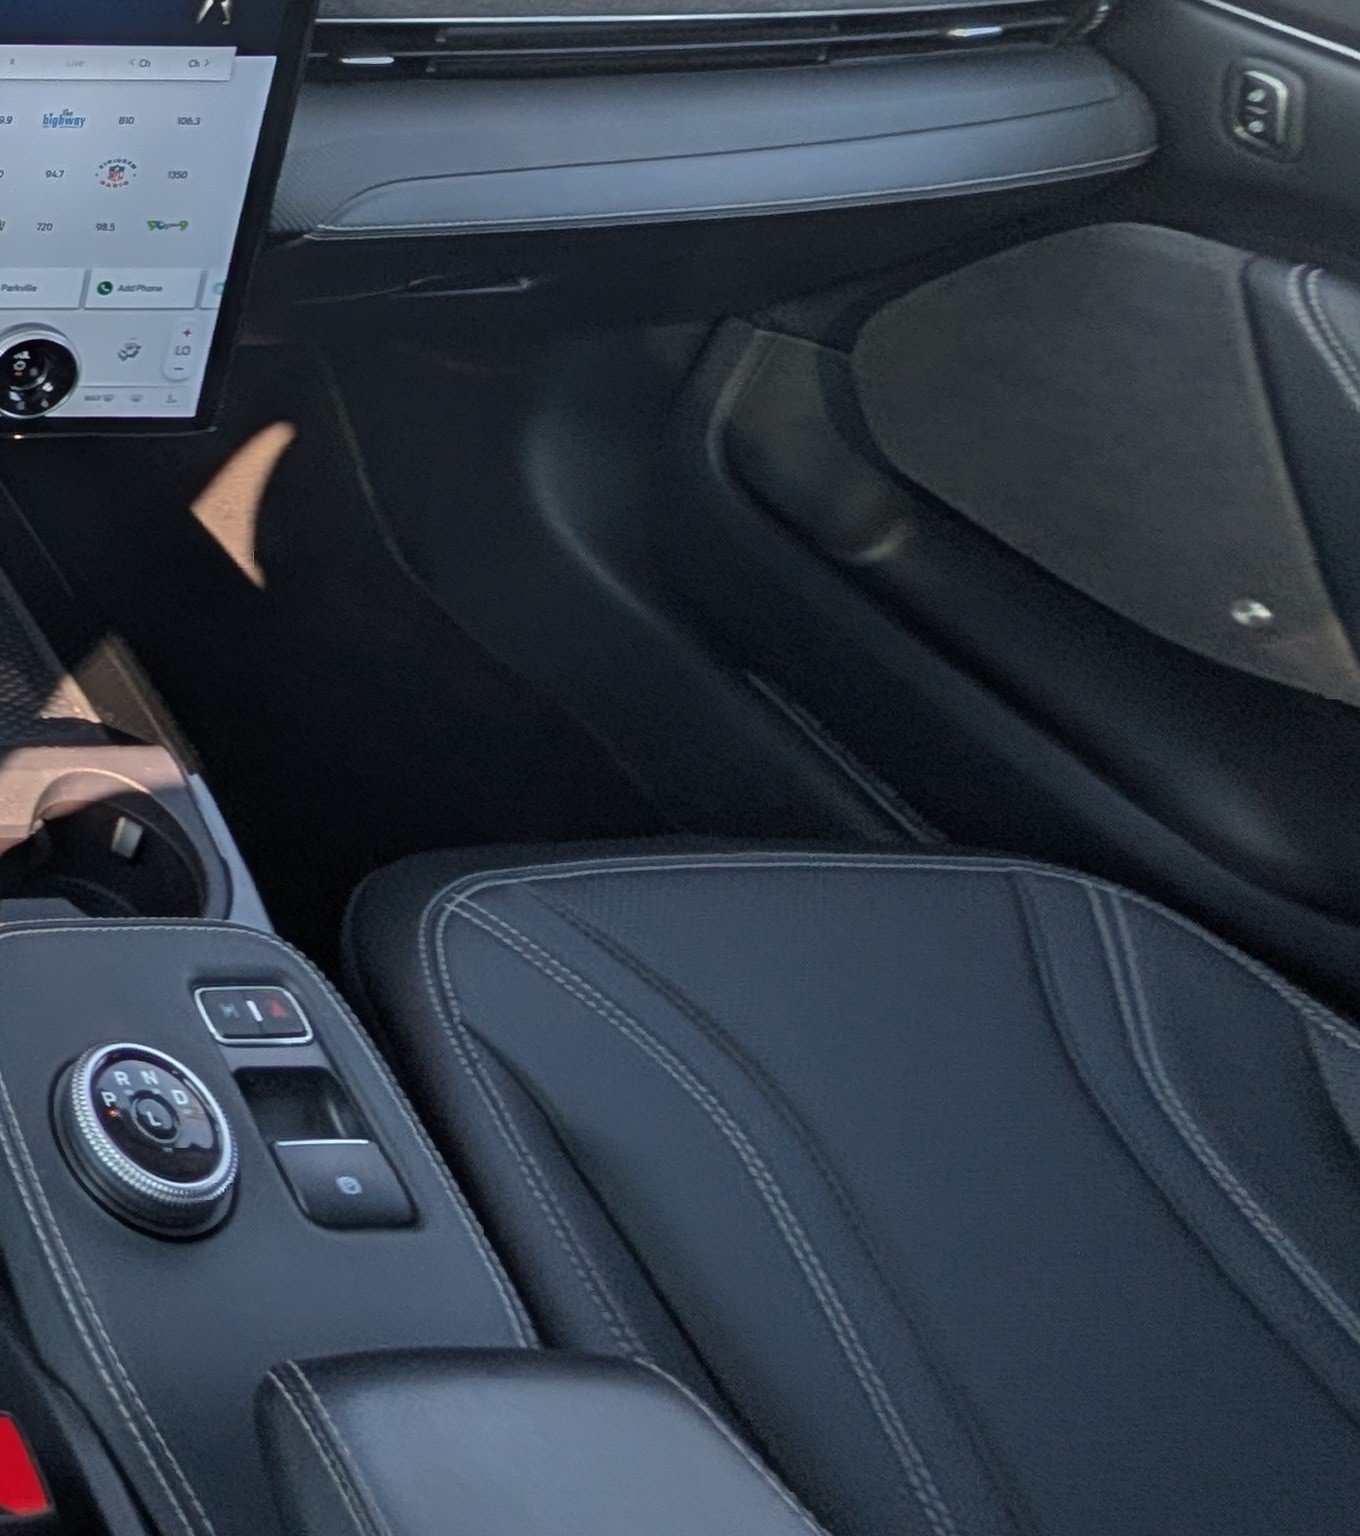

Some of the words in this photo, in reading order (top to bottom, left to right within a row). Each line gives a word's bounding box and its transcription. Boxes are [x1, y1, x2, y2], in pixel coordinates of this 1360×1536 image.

[42, 113, 86, 128] highway
[135, 284, 163, 293] Phone
[114, 1070, 131, 1086] R
[140, 1070, 159, 1085] N
[101, 1090, 117, 1108] P
[172, 1089, 189, 1105] D
[145, 1110, 162, 1127] L
